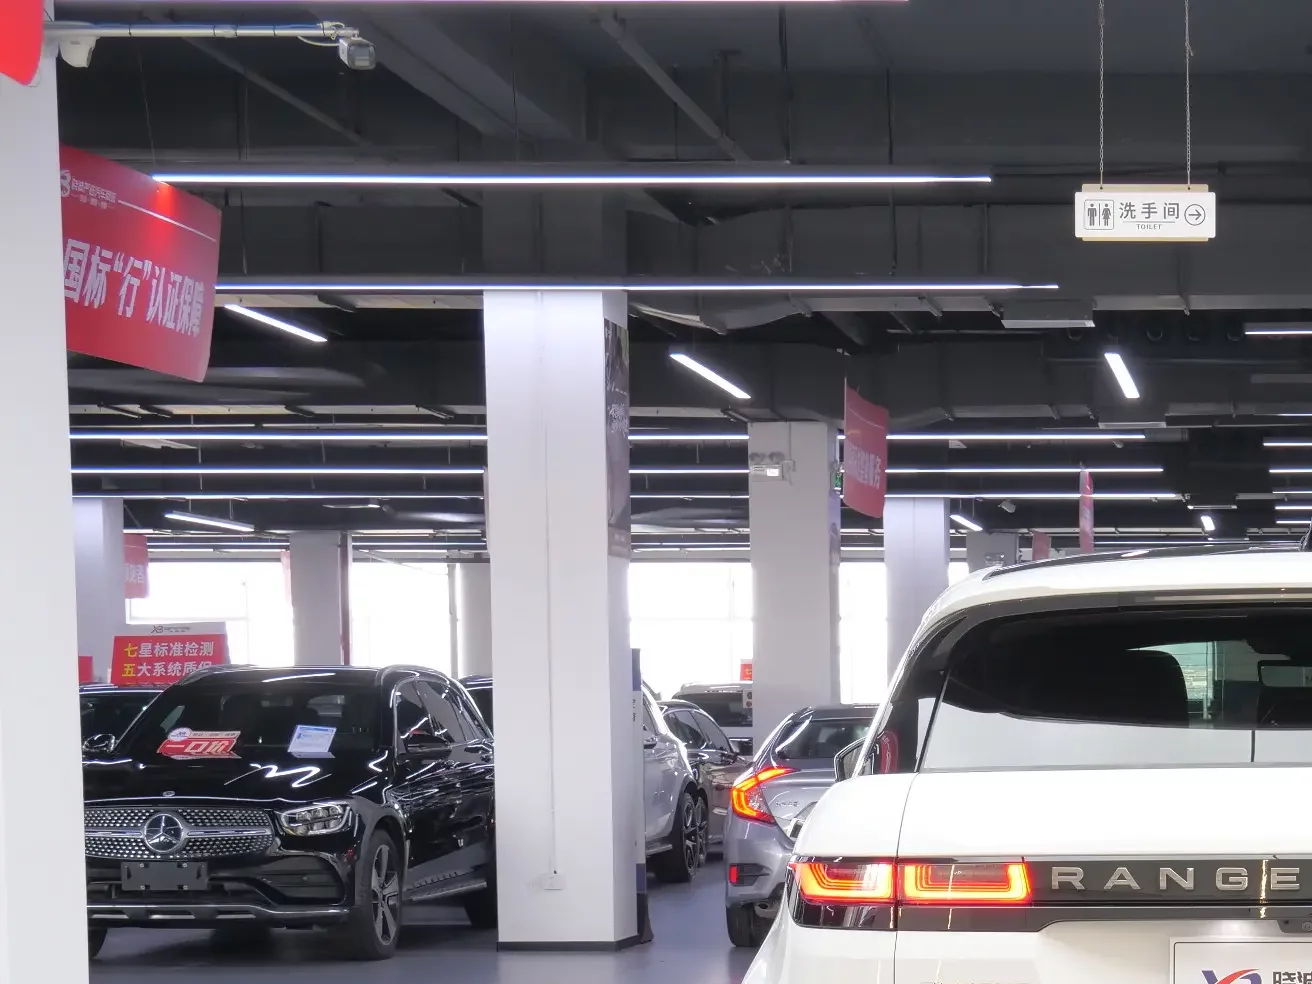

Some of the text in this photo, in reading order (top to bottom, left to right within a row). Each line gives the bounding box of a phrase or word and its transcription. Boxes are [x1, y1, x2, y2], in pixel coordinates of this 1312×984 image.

[1119, 202, 1180, 220] 洗手间
[124, 641, 214, 657] 七星标准检测
[1051, 866, 1301, 891] RANGE
